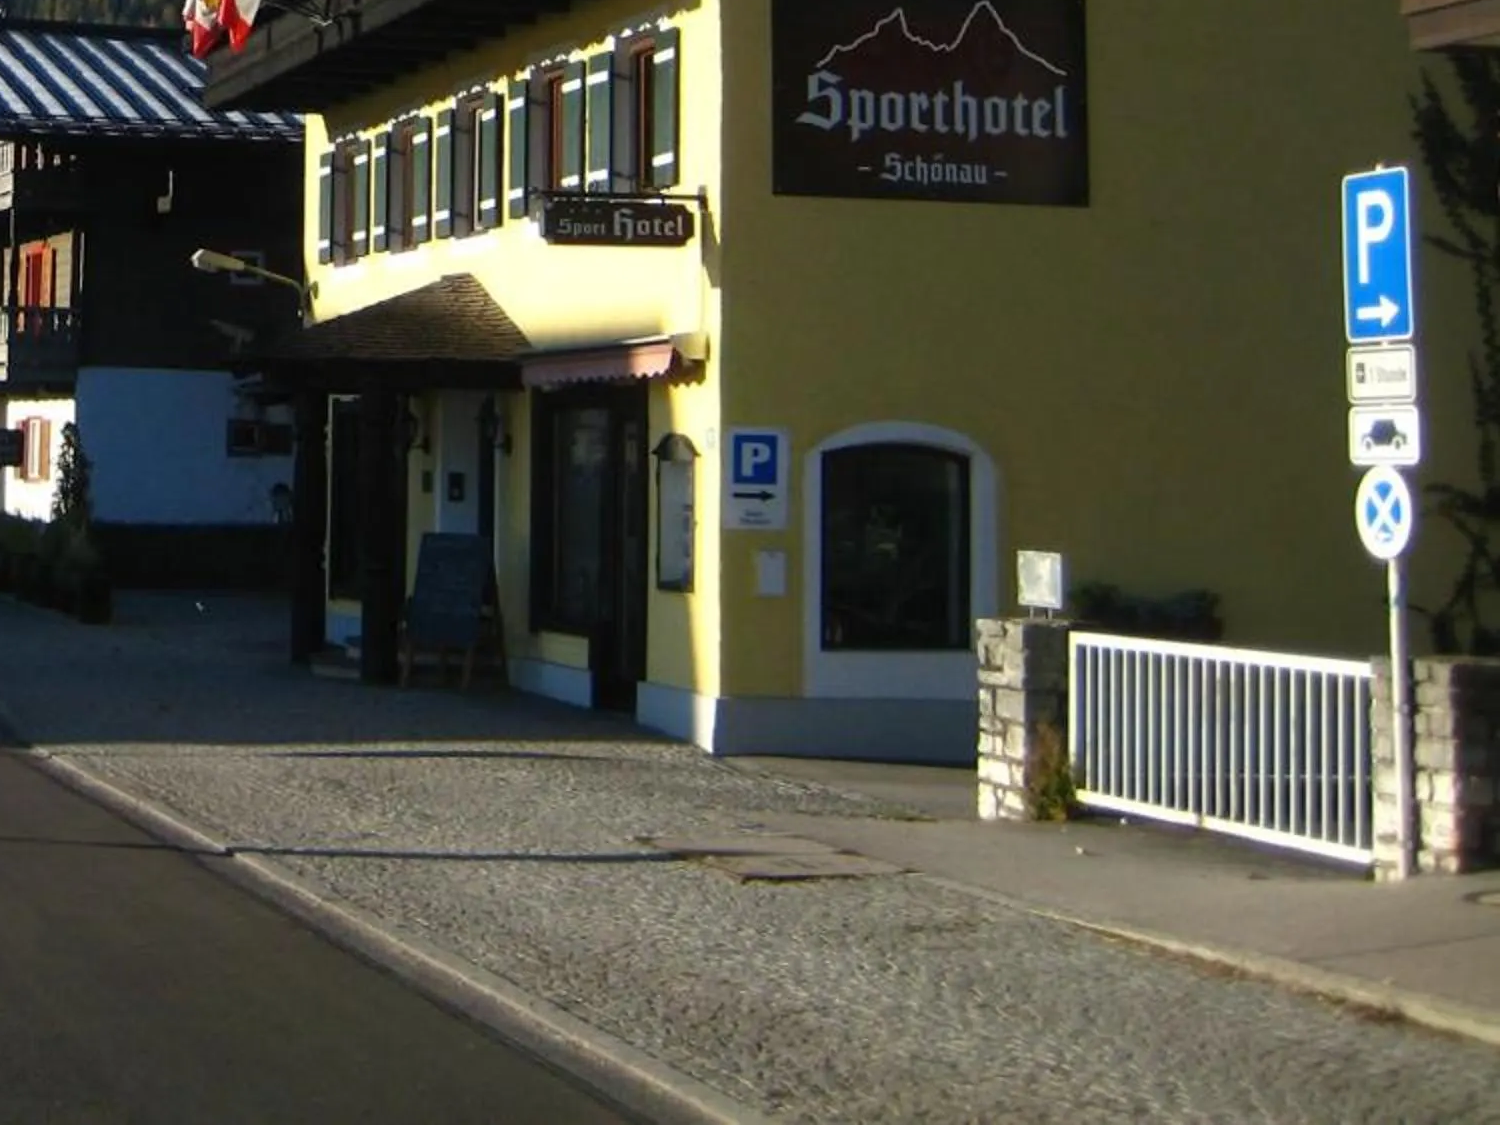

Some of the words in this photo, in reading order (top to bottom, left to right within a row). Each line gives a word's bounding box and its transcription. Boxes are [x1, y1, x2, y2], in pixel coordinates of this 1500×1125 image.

[796, 70, 1069, 142] Sporthotel
[556, 217, 606, 236] Sport
[612, 207, 684, 241] Hotel
[1355, 188, 1394, 285] P
[740, 441, 771, 478] P
